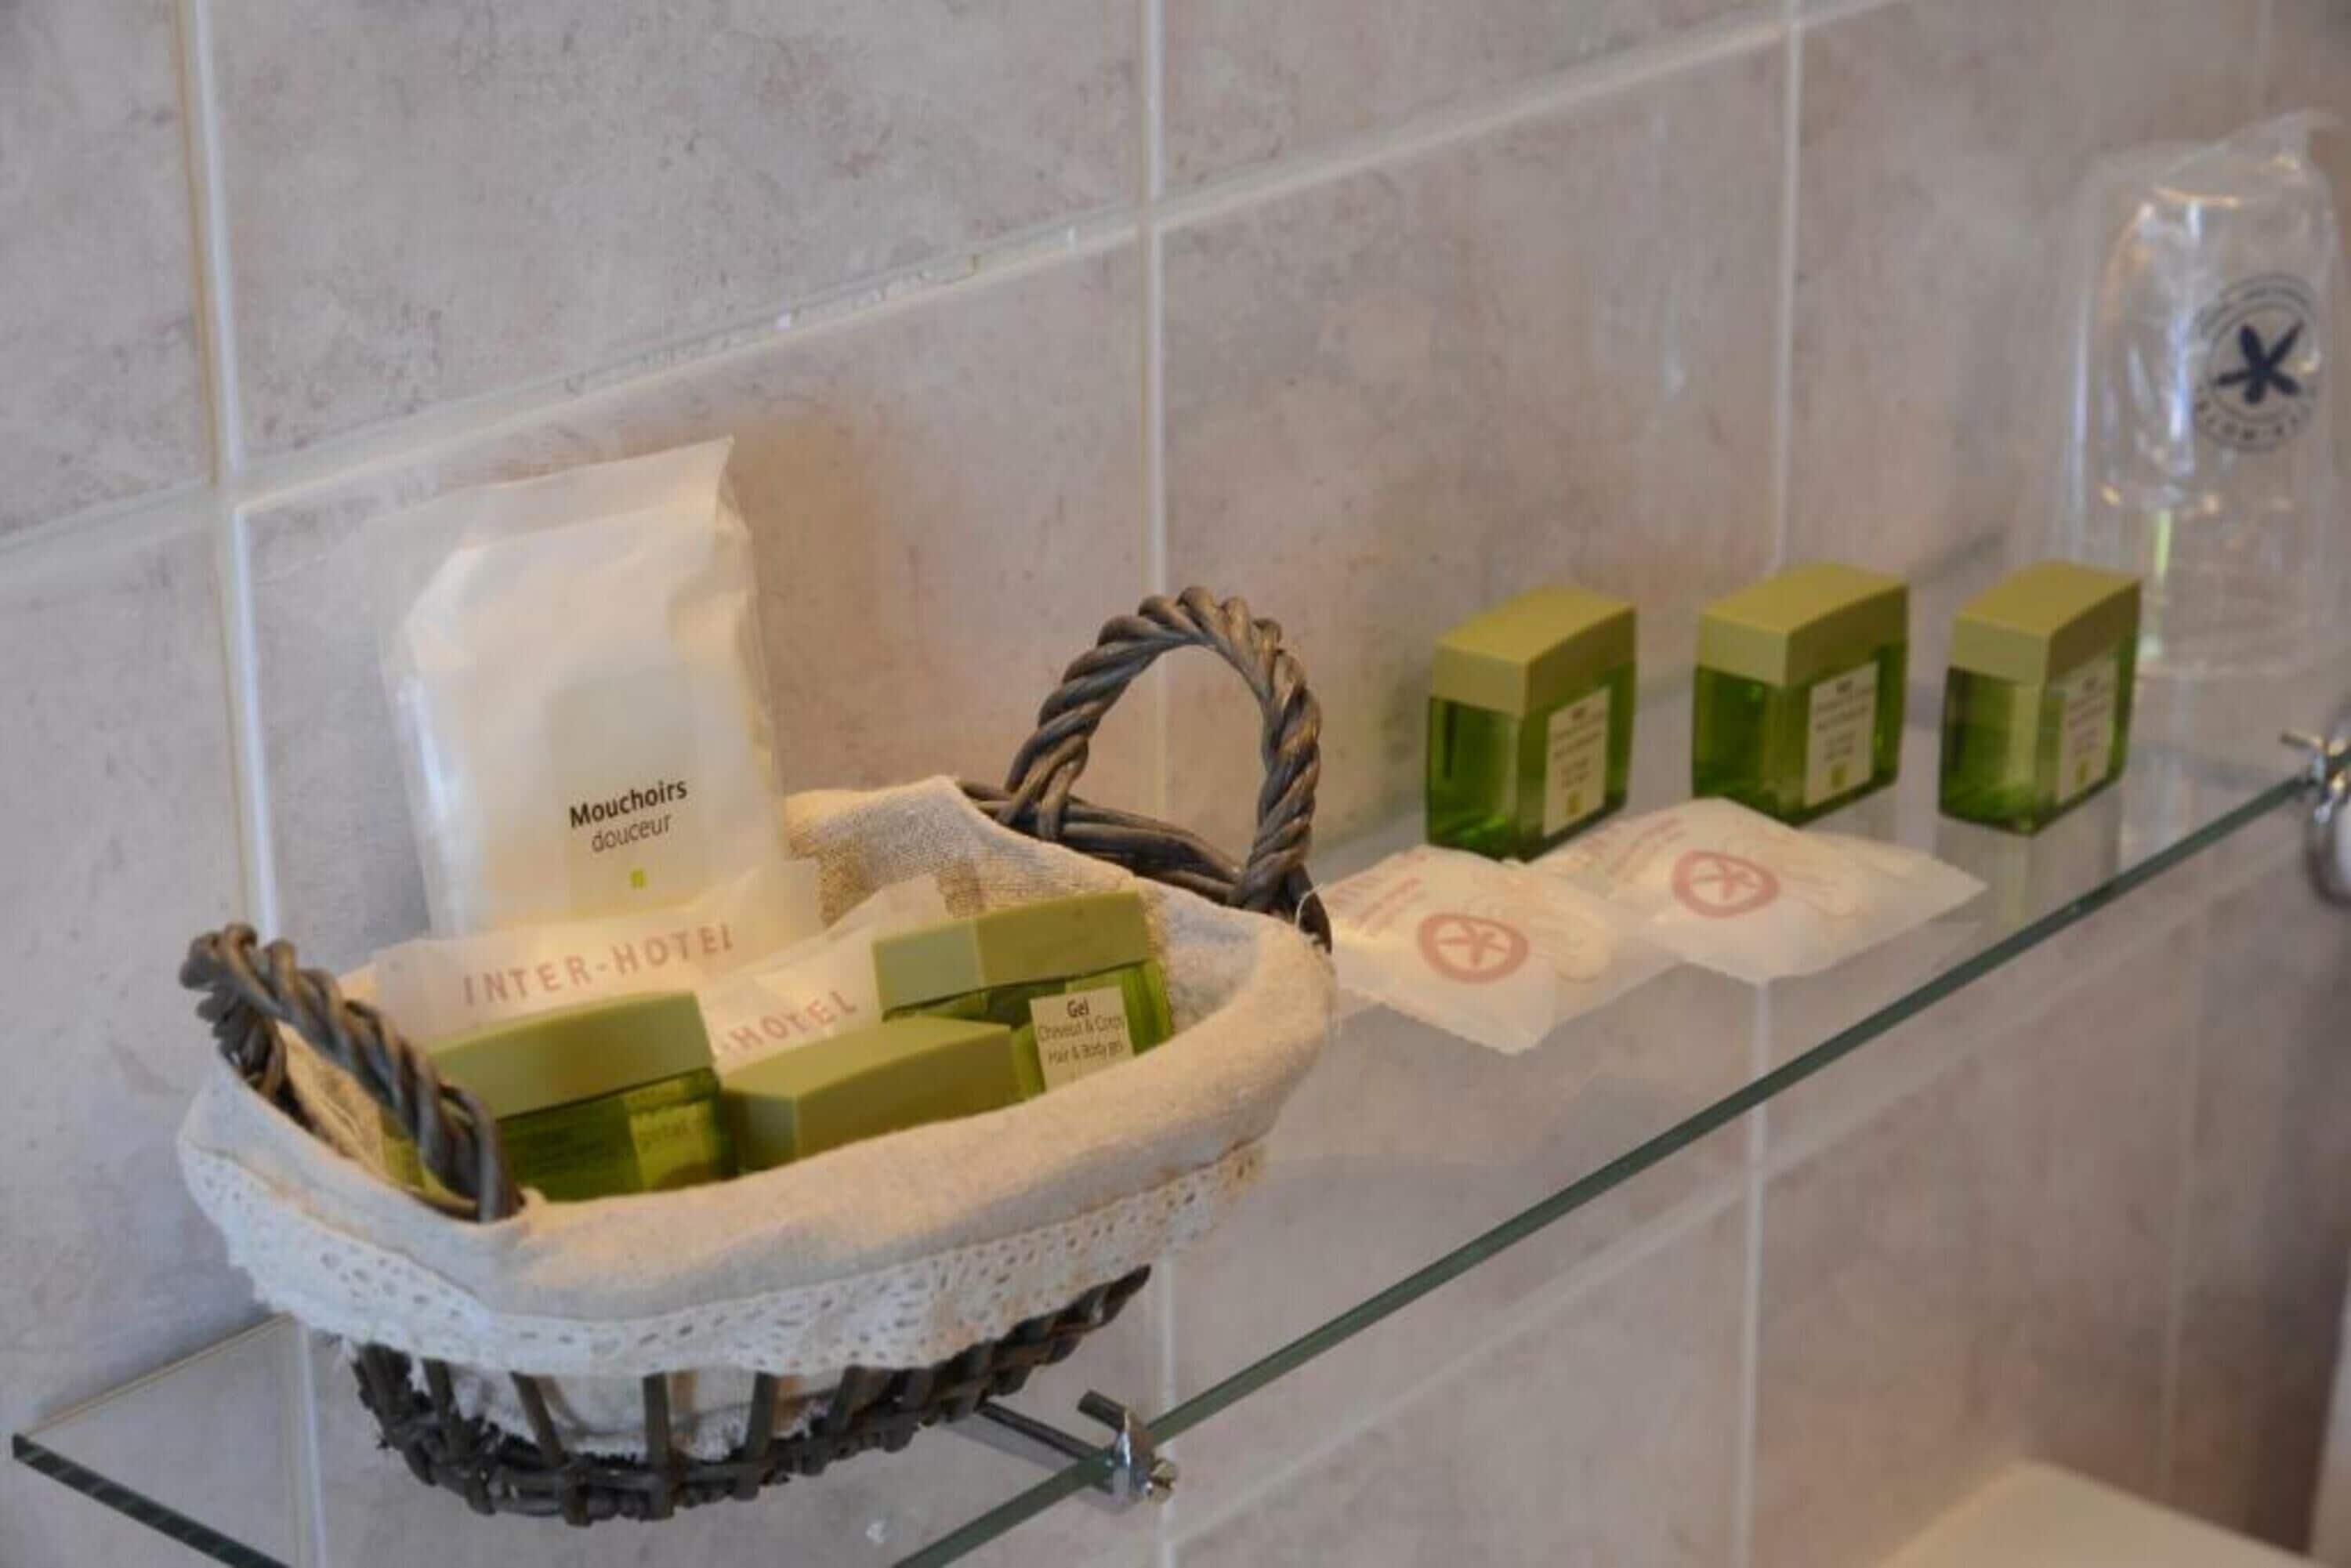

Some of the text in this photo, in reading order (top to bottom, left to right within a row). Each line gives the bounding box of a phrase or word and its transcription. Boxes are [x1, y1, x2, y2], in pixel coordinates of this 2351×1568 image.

[570, 780, 687, 828] Mouchoirs
[592, 814, 672, 853] douceur
[1067, 996, 1089, 1018] Gel
